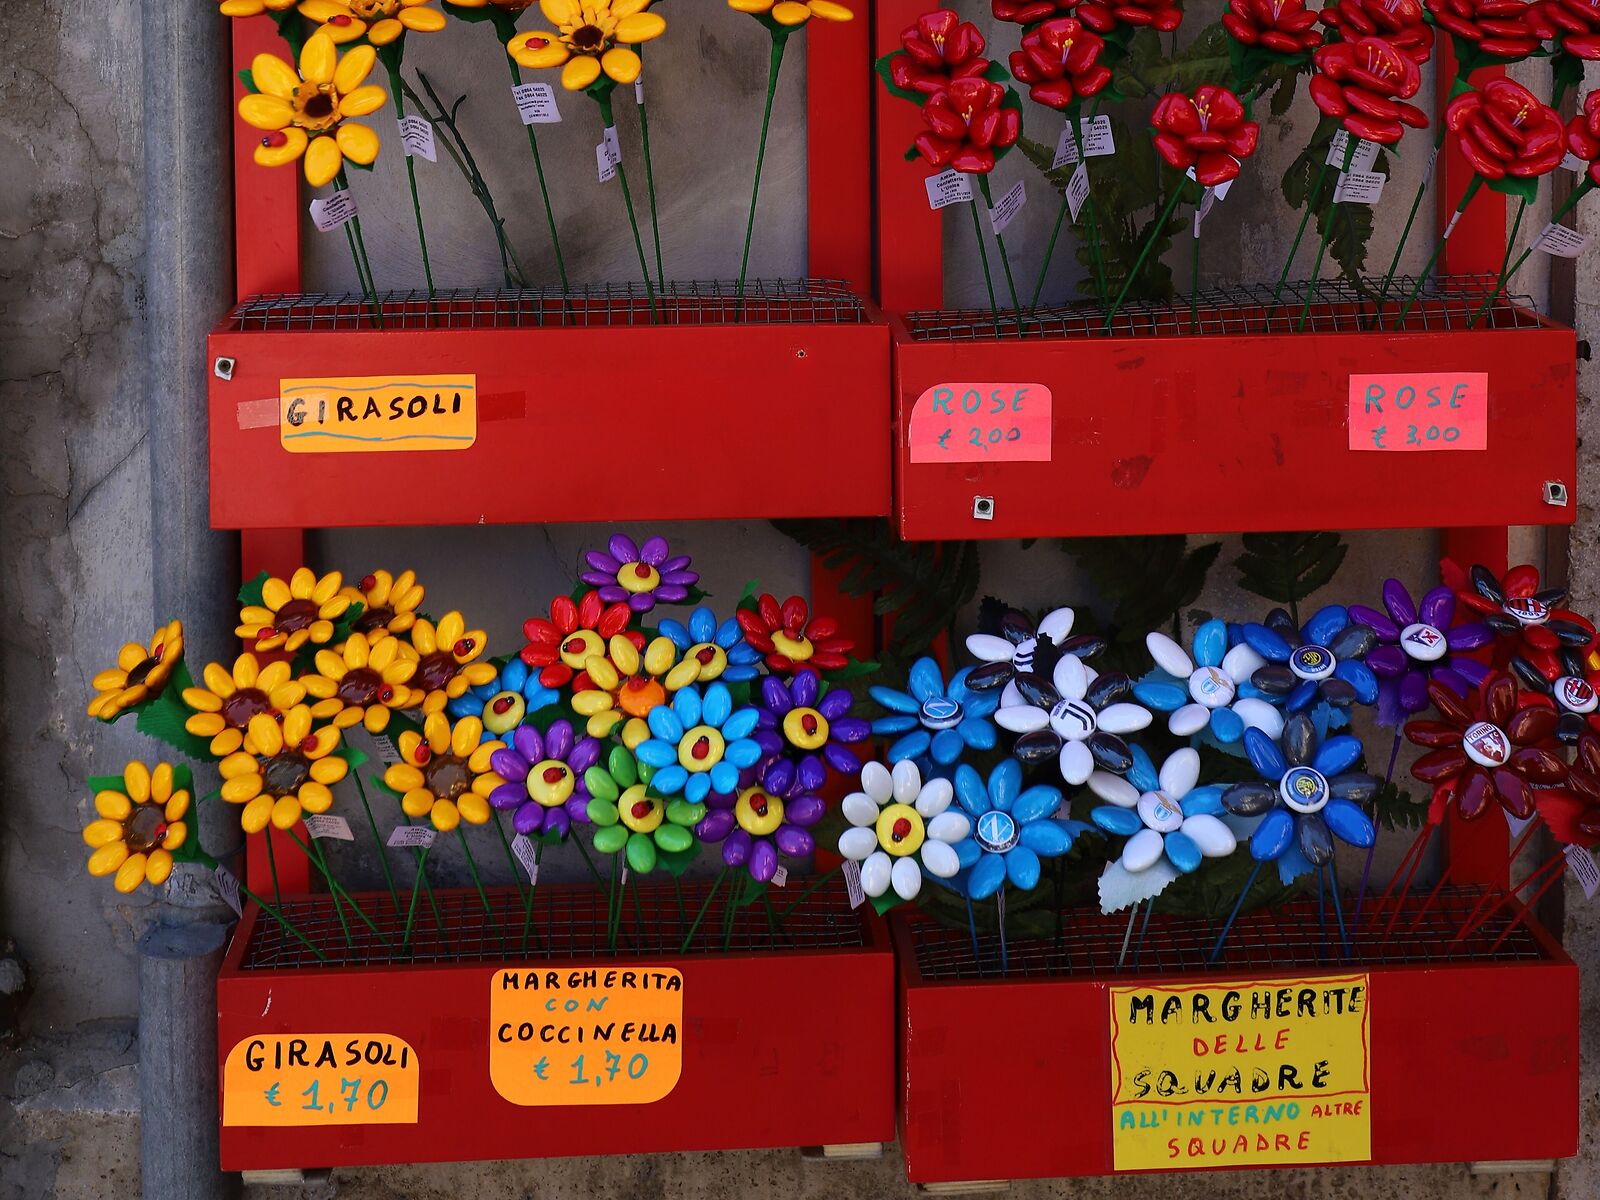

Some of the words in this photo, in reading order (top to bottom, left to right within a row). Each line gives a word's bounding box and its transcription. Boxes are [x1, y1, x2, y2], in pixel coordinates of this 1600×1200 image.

[287, 393, 461, 426] GIRASOLI
[933, 388, 1029, 415] ROSE
[1365, 384, 1468, 413] ROSE
[969, 427, 1020, 452] 2,00
[1406, 424, 1460, 446] 3,00
[1468, 725, 1493, 741] TORINO
[502, 970, 682, 991] MARGHERITA
[545, 996, 608, 1012] CON
[1129, 986, 1365, 1025] MARGHERITE
[498, 1022, 677, 1044] COCCINELLA
[1193, 1028, 1290, 1057] DELLE
[246, 1039, 408, 1072] GIRASOLI
[533, 1056, 550, 1080] €
[569, 1050, 648, 1087] 1,70
[1133, 1060, 1330, 1099] SQUADRE
[264, 1081, 282, 1107] €
[302, 1077, 388, 1114] 1,70
[1311, 1100, 1363, 1118] ALTRE
[1167, 1131, 1311, 1158] SQUADRE
